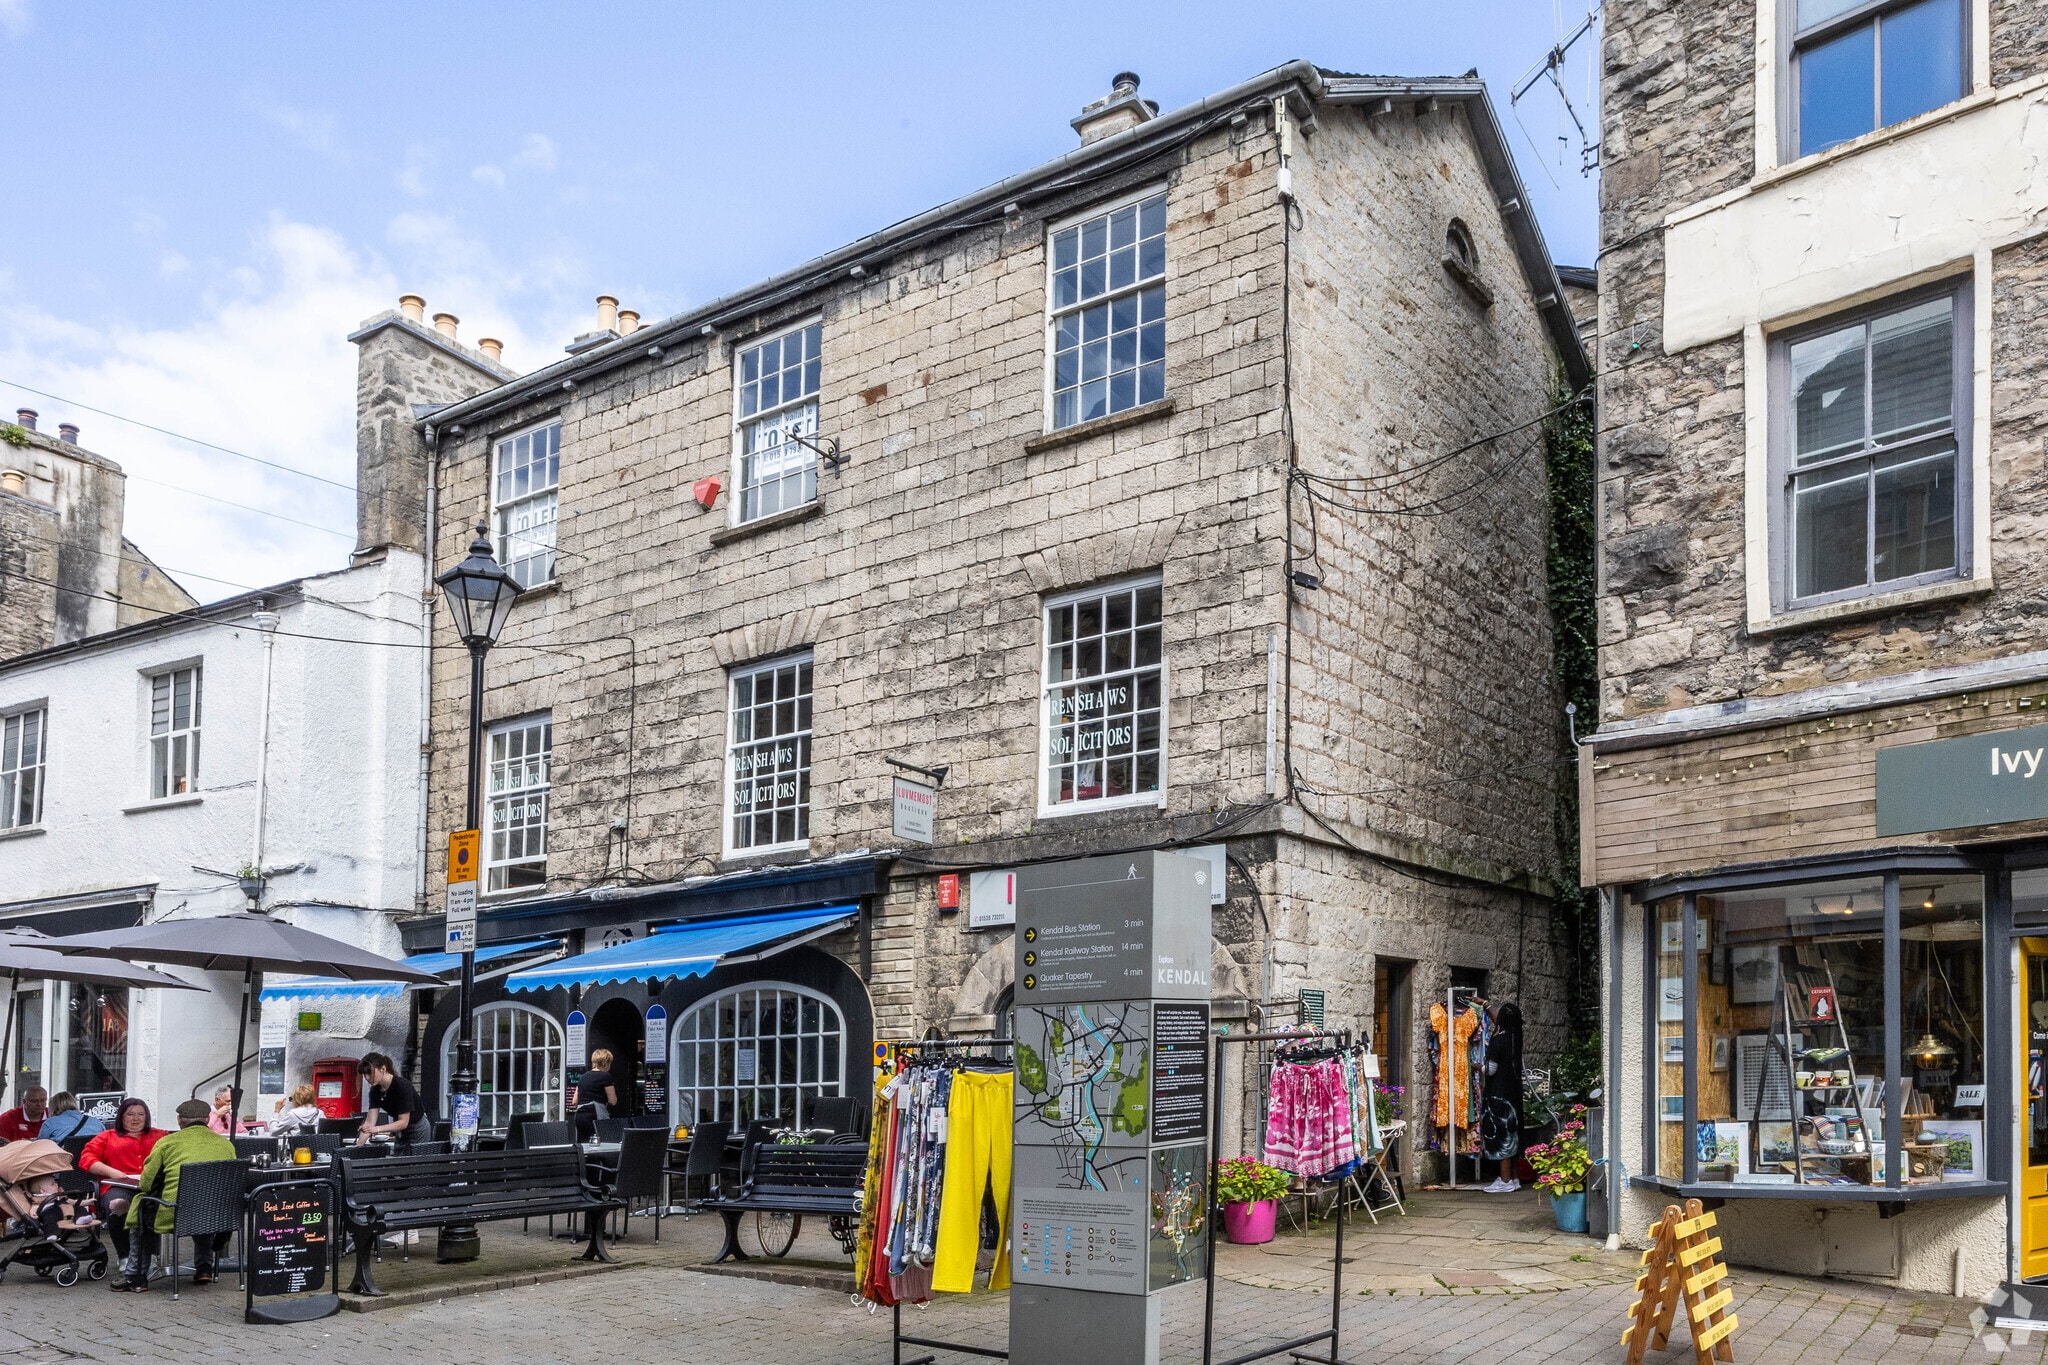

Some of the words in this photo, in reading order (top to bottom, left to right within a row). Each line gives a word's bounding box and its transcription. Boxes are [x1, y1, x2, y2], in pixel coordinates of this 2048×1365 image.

[1051, 687, 1127, 716] RENSHAWS
[1051, 726, 1131, 756] SOLICITORS
[735, 747, 793, 772] RENSHAWS
[1991, 747, 2045, 778] Ivy
[734, 782, 796, 806] SOLICITORS
[493, 803, 542, 823] SOLICITORS
[453, 833, 475, 841] Pedestrian
[1040, 925, 1064, 935] Kendal
[1064, 925, 1077, 933] Bus
[1078, 923, 1101, 932] Station
[1124, 919, 1129, 928] 3
[1130, 919, 1144, 927] min
[1040, 947, 1064, 957] Kendal
[1064, 946, 1090, 955] Railway
[1090, 944, 1114, 953] Station
[1121, 942, 1129, 951] 14
[1130, 942, 1144, 950] min
[1158, 955, 1174, 964] Explore
[1040, 973, 1064, 982] Quaker
[1065, 971, 1093, 982] Tapestry
[1123, 968, 1129, 976] 4
[1129, 968, 1143, 976] min
[1158, 968, 1208, 986] KENDAL
[1959, 1090, 1980, 1099] SALE
[264, 1201, 278, 1212] Best
[281, 1200, 294, 1210] Iced
[296, 1201, 311, 1209] Coffee
